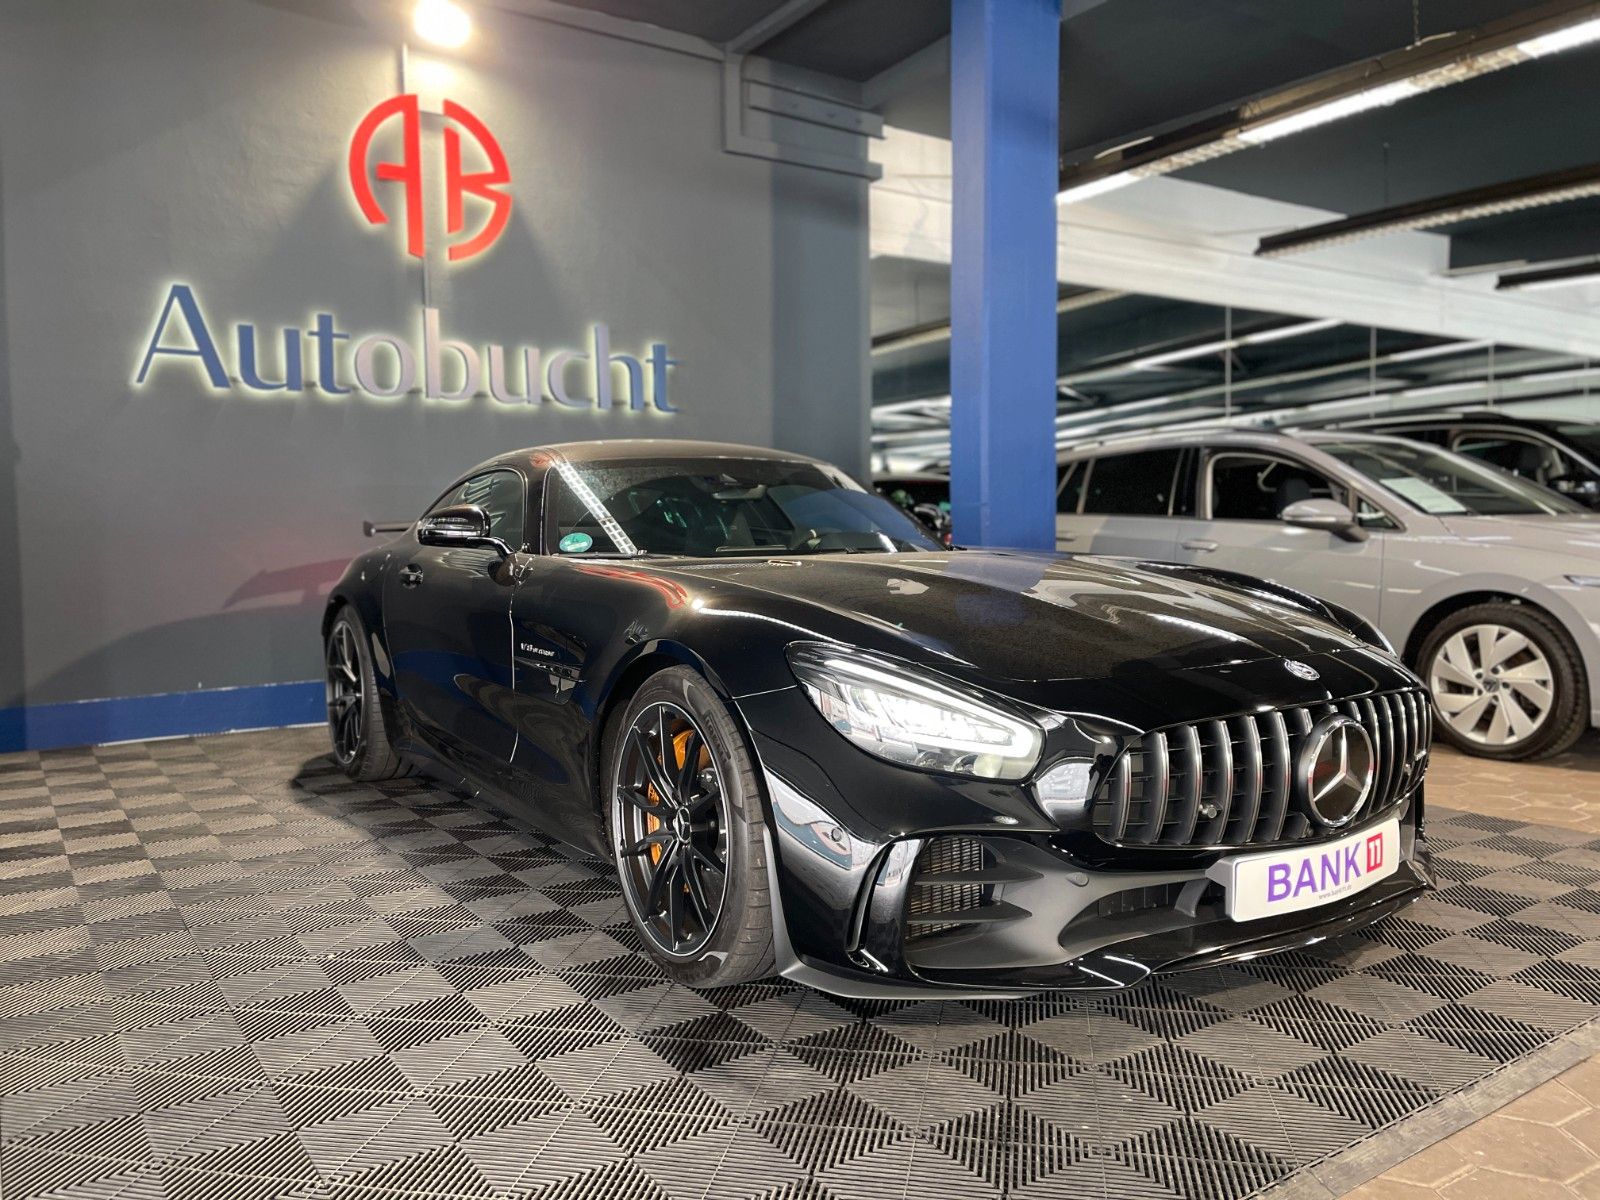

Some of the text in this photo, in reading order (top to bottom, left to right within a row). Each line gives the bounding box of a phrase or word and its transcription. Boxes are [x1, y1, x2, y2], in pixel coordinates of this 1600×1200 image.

[348, 93, 512, 261] AB
[136, 283, 682, 413] Autobucht
[1267, 841, 1361, 902] BANK
